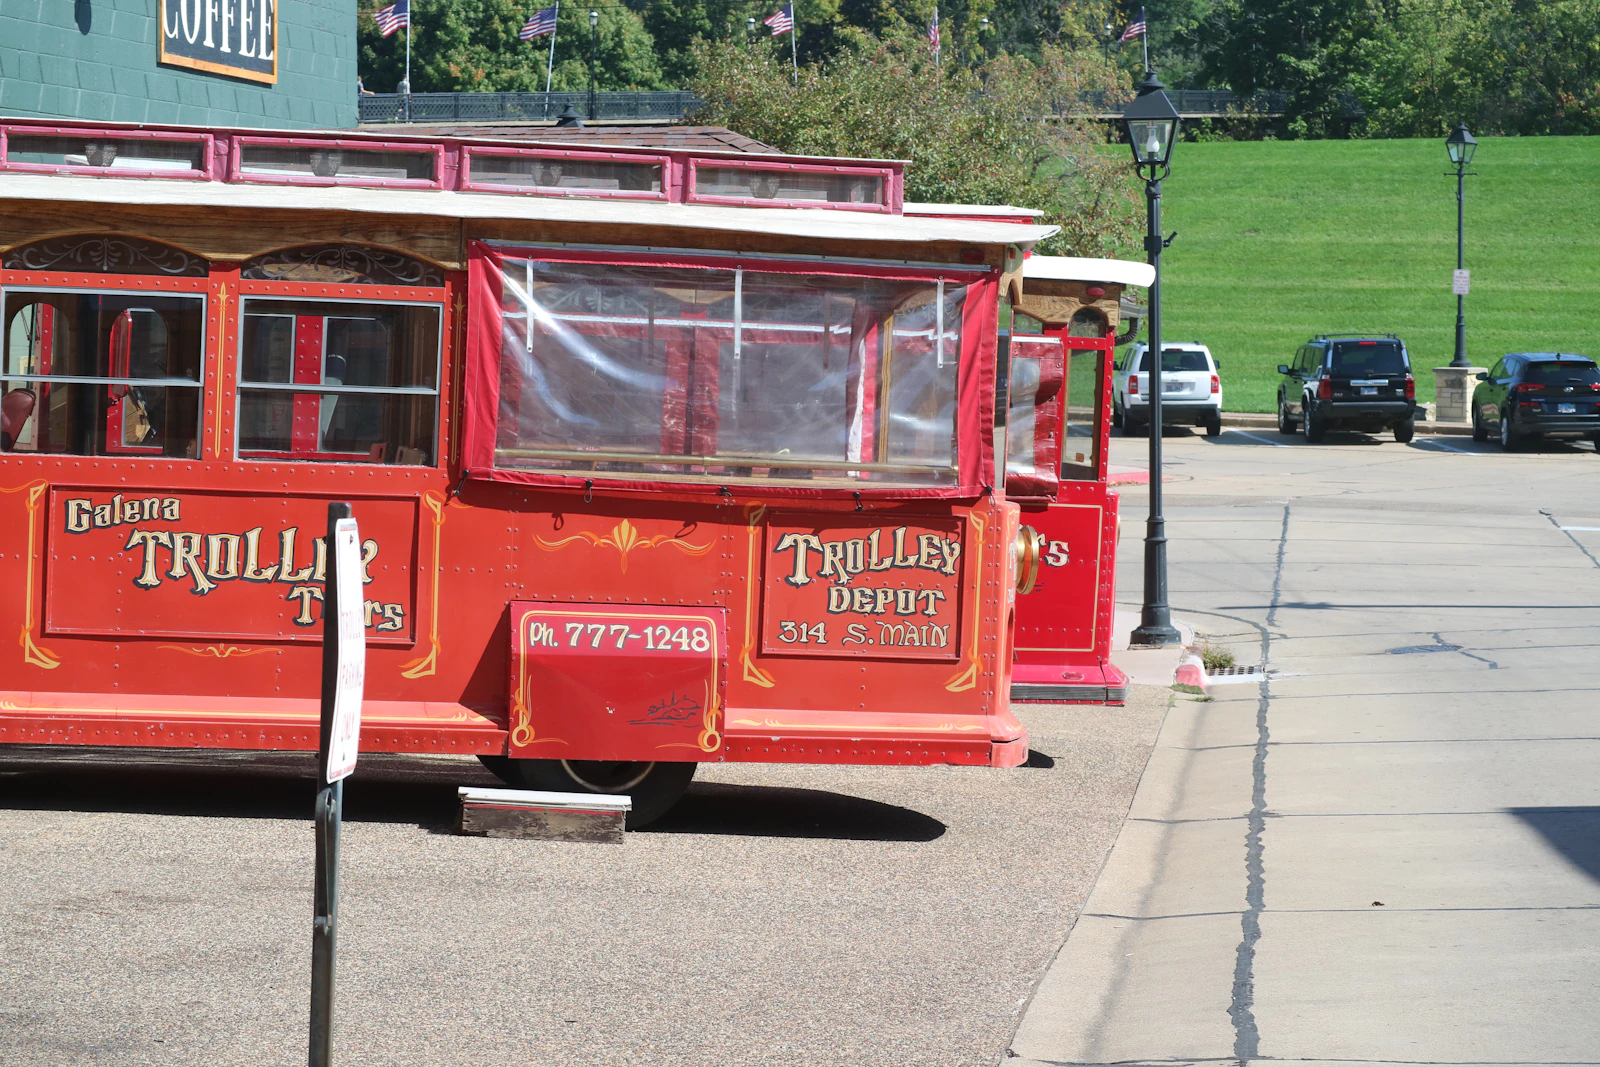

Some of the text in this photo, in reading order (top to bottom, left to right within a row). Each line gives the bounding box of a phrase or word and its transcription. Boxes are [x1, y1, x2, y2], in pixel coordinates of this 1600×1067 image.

[163, 0, 274, 61] COFFEE
[65, 494, 181, 533] Galena
[773, 526, 962, 587] TROLLEY
[827, 586, 946, 617] DEPOT
[529, 622, 711, 652] Ph. 777-1248
[778, 621, 828, 644] 314
[874, 620, 950, 648] MAIN
